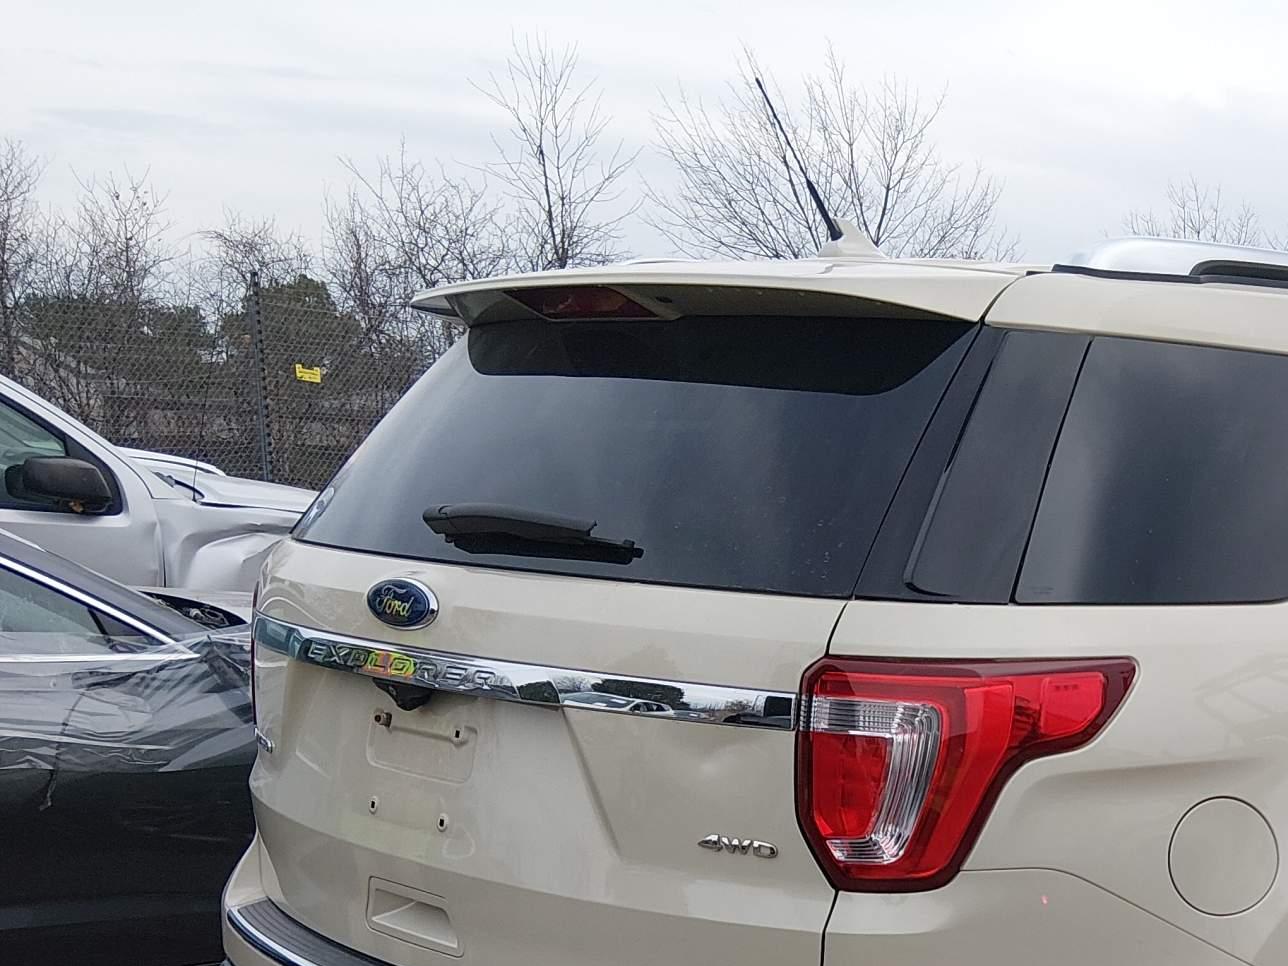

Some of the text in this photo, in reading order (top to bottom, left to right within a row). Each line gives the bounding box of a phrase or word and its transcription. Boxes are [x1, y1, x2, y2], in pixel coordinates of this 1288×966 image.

[375, 584, 415, 618] Ford
[307, 641, 498, 690] EXPLORER
[697, 833, 779, 859] 4WD
